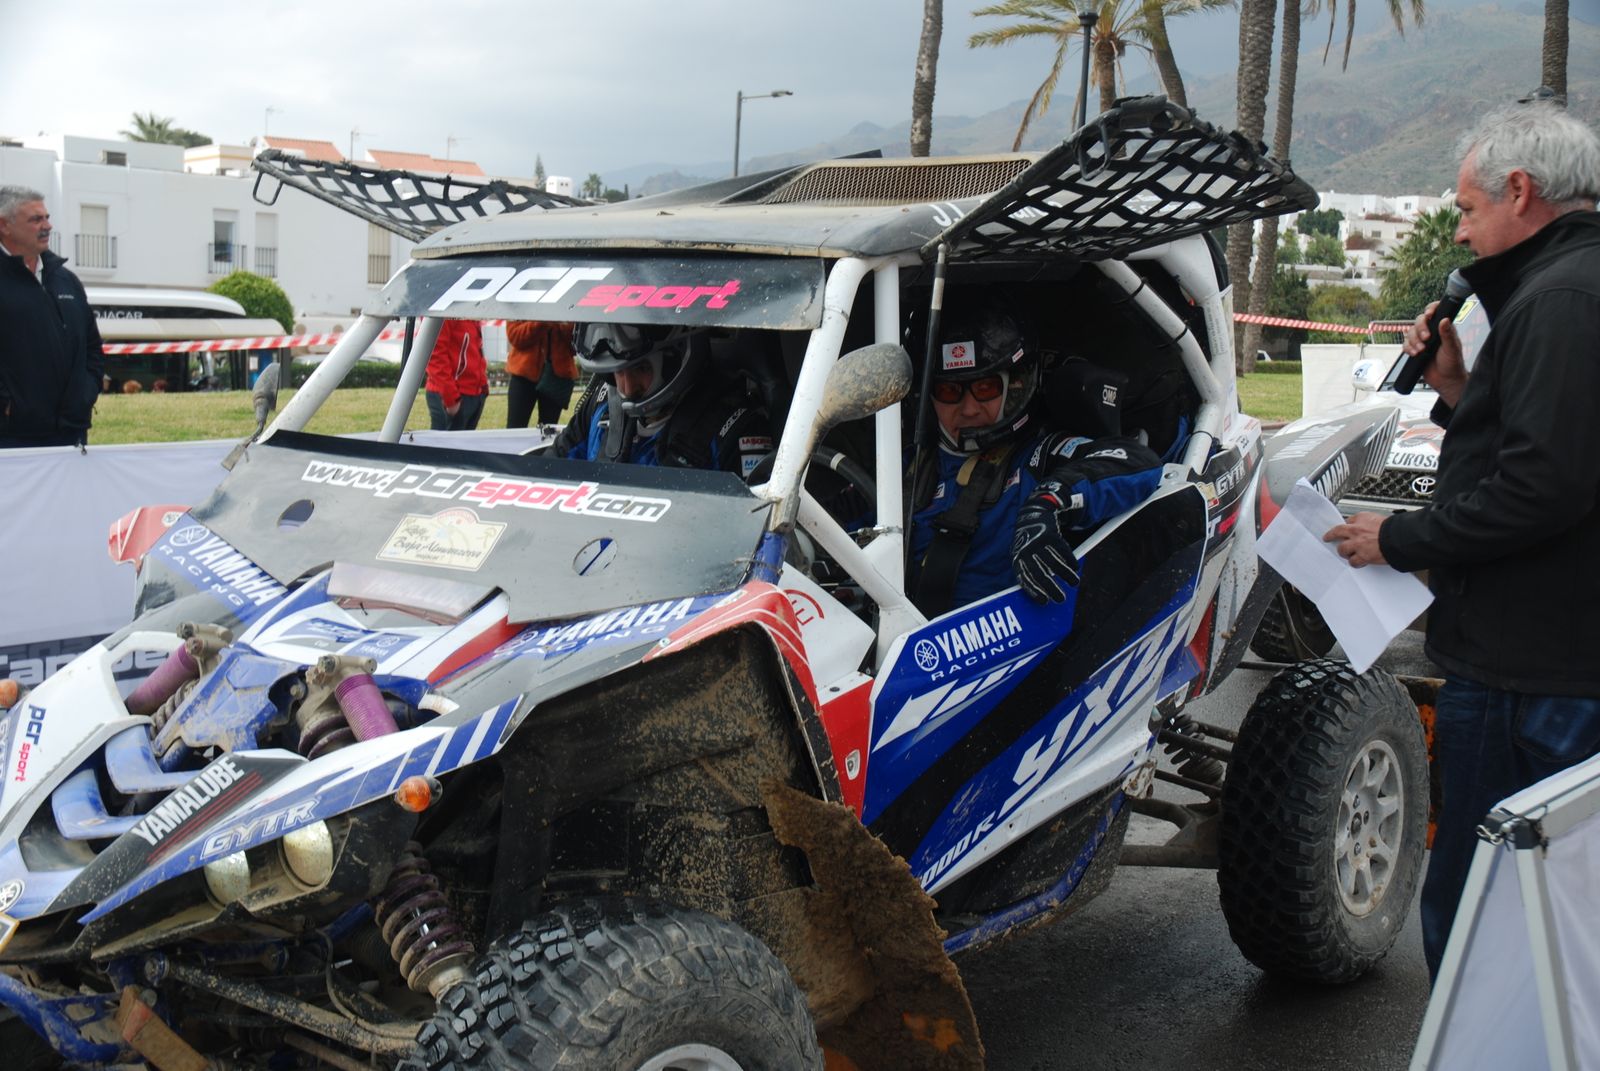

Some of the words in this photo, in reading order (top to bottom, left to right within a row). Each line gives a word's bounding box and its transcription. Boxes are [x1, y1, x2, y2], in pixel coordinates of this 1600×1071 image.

[428, 266, 613, 311] pcr
[576, 279, 741, 313] sport
[945, 359, 974, 368] YAMAHA
[304, 462, 668, 519] www.pcrsport.com
[1314, 451, 1350, 499] AMAHA
[159, 544, 244, 606] RACING
[188, 536, 288, 606] YAMAHA
[537, 597, 695, 646] YAMAHA
[935, 605, 1023, 662] YAMAHA
[931, 637, 1021, 681] RACING
[26, 703, 46, 745] pcr
[15, 742, 31, 782] sport
[131, 755, 245, 846] YAMALUBE
[200, 798, 320, 859] GYTR
[919, 811, 997, 890] 000R
